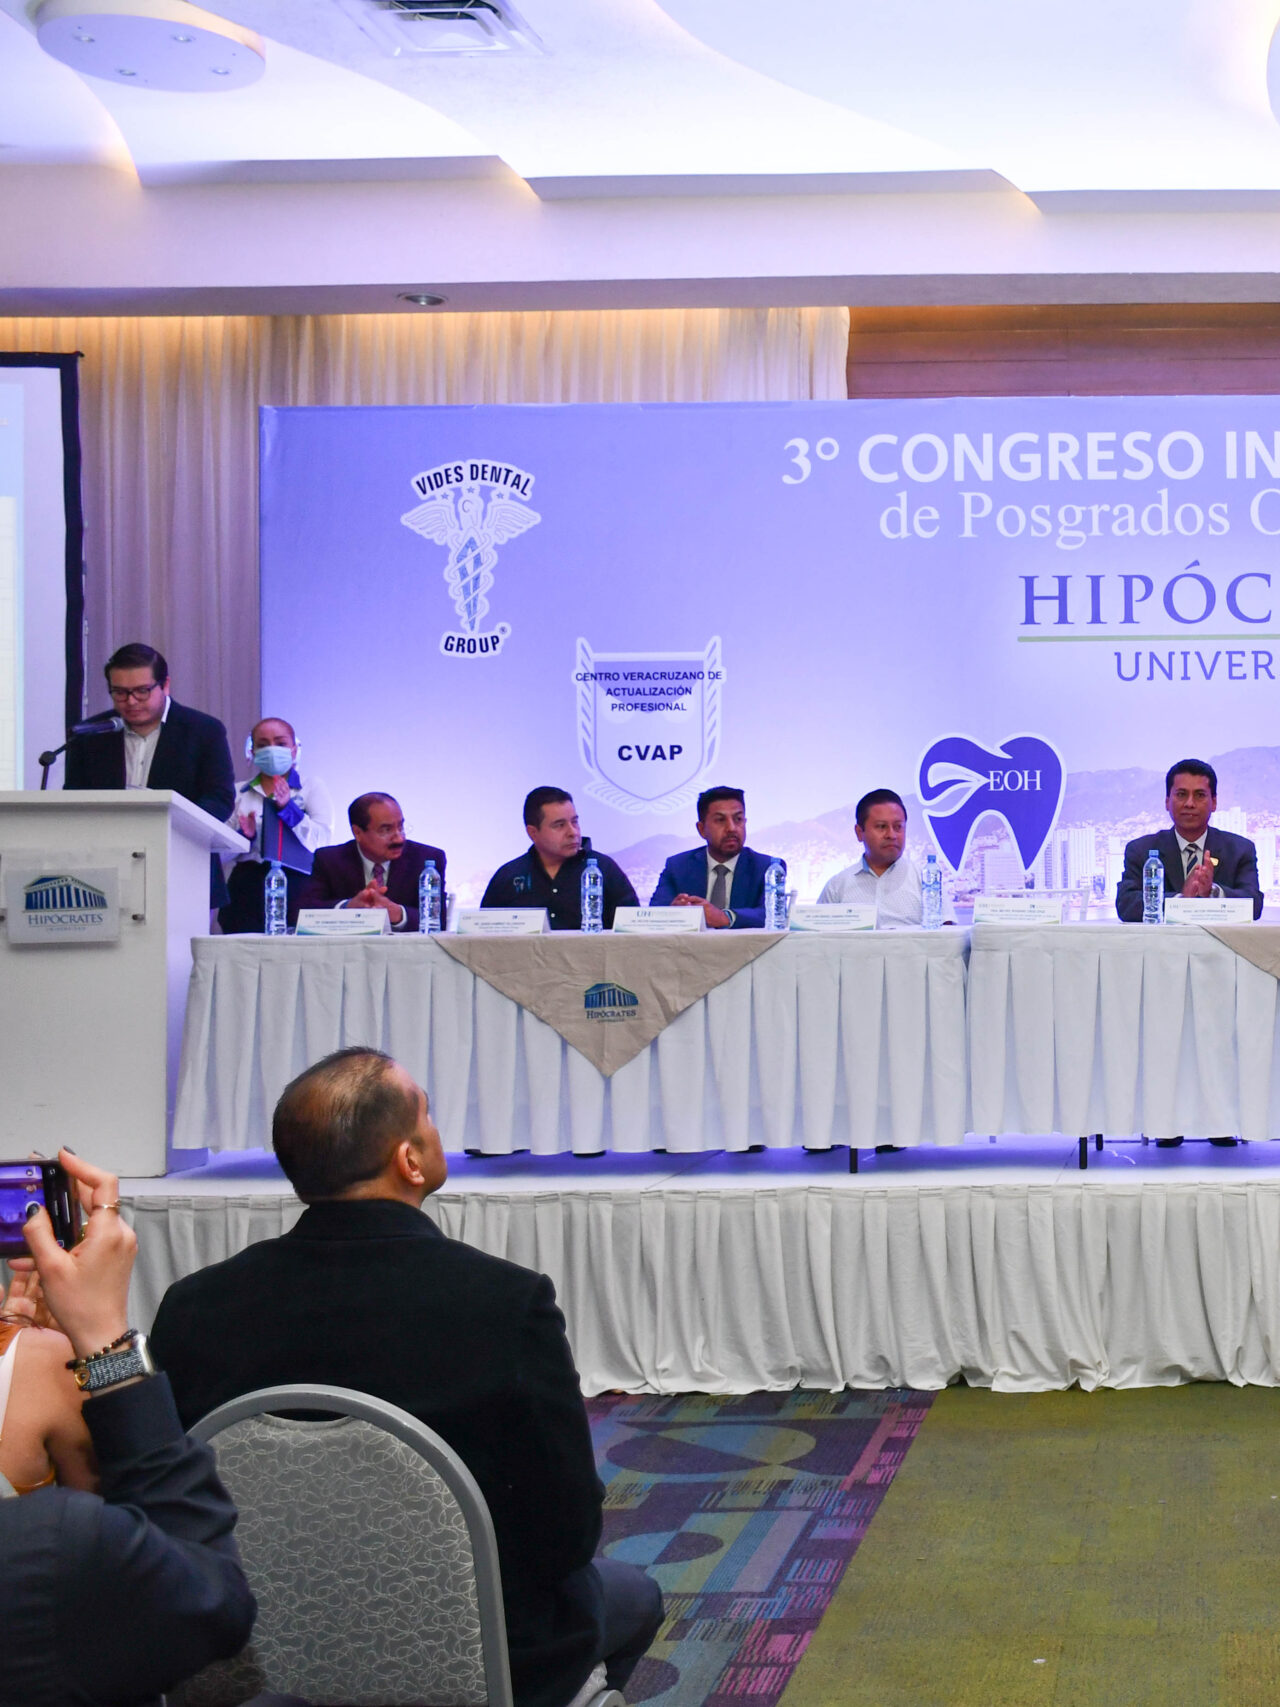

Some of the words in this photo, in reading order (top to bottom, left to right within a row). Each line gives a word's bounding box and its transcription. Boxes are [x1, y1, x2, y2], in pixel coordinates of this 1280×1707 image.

[858, 430, 1205, 484] CONGRESO
[416, 465, 464, 496] VIDES
[470, 463, 533, 496] DENTAL
[879, 490, 941, 540] de
[958, 488, 1231, 551] Posgrados
[443, 634, 501, 655] GROUP
[575, 671, 621, 683] CENTRO
[623, 671, 706, 683] VERACRUZANO
[708, 670, 723, 681] DE
[605, 684, 693, 697] ACTUALIZACIÓN
[611, 702, 688, 713] PROFESIONAL
[617, 745, 684, 761] CVAP
[988, 769, 1042, 791] EOH
